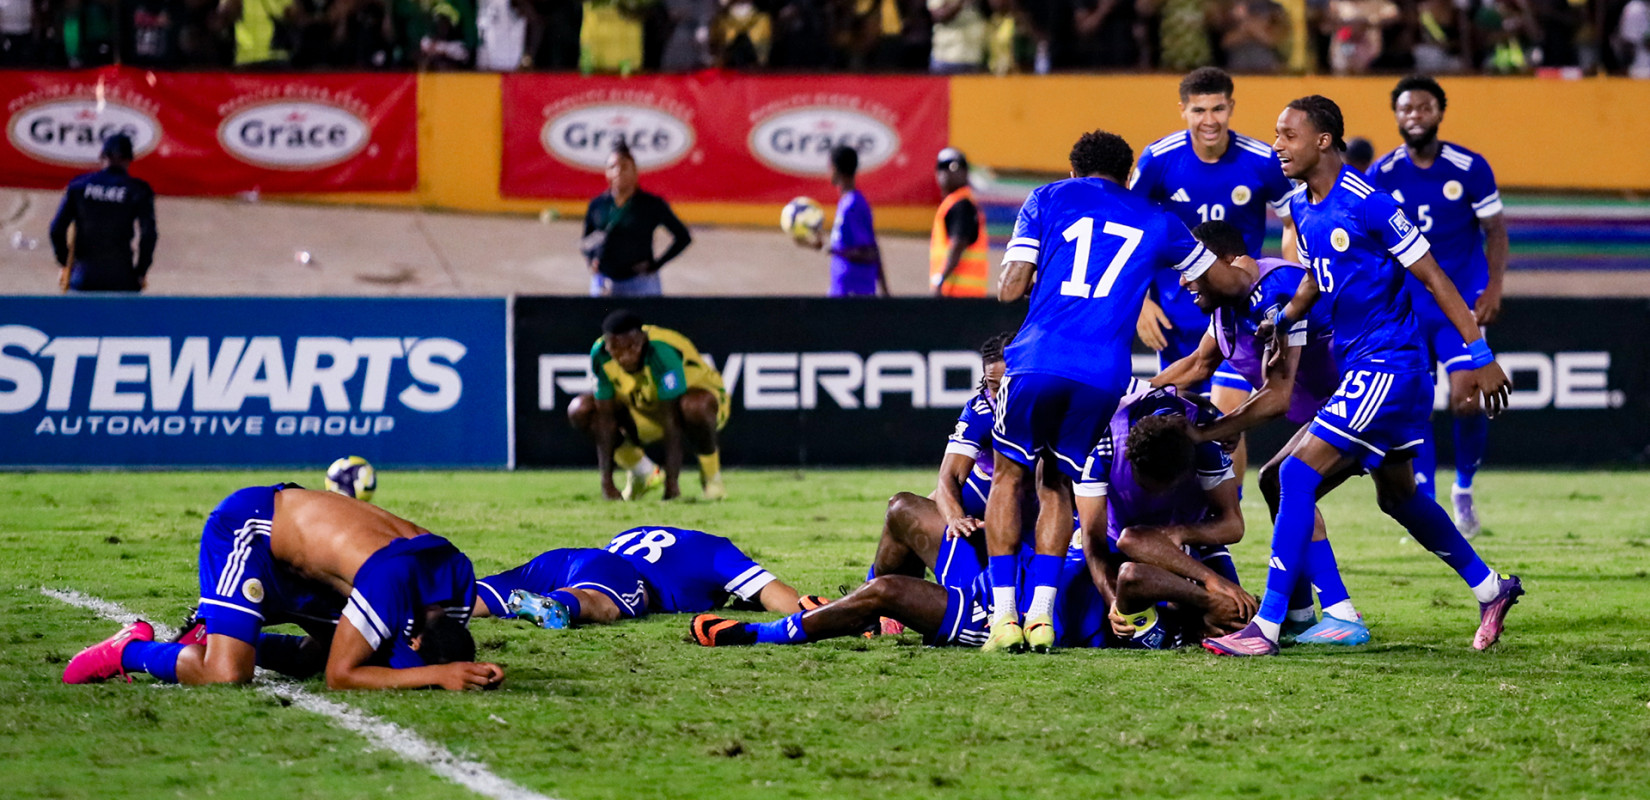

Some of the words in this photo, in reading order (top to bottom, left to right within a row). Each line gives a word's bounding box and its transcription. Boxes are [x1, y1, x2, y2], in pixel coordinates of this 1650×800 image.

[238, 119, 346, 147] Grace
[564, 122, 670, 151] Grace
[84, 183, 127, 203] POLICE
[1417, 204, 1433, 232] 5
[1060, 216, 1144, 299] 17
[1313, 257, 1334, 293] 15
[0, 325, 467, 413] STEWART'S
[1334, 370, 1372, 399] 15
[35, 416, 265, 435] AUTOMOTIVE
[275, 416, 395, 435] GROUP
[608, 529, 676, 564] 18
